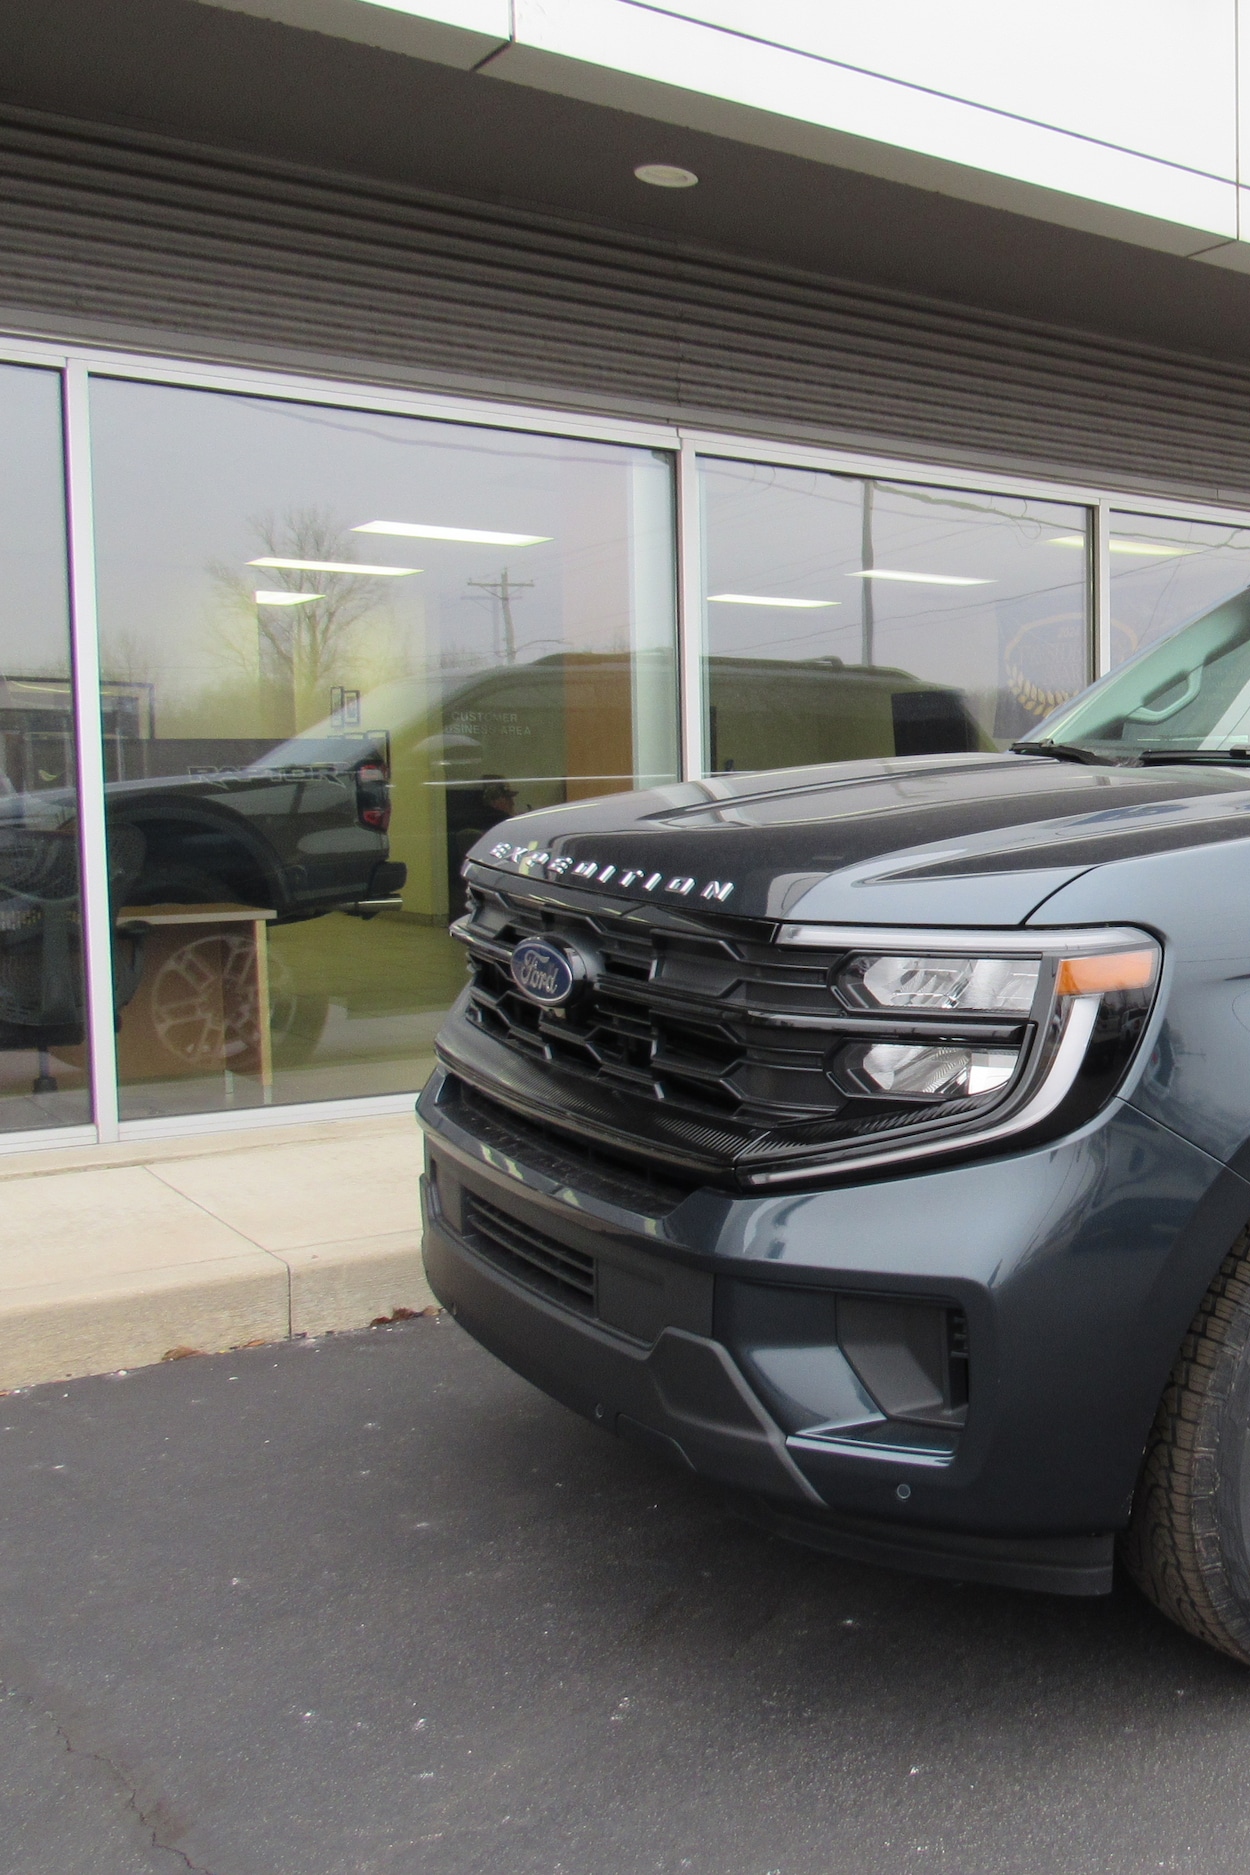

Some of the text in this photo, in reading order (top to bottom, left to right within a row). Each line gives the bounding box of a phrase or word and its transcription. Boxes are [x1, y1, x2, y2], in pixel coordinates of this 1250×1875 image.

[501, 725, 532, 736] AREA
[489, 841, 735, 902] EXPEDITION
[520, 949, 560, 994] Ford
